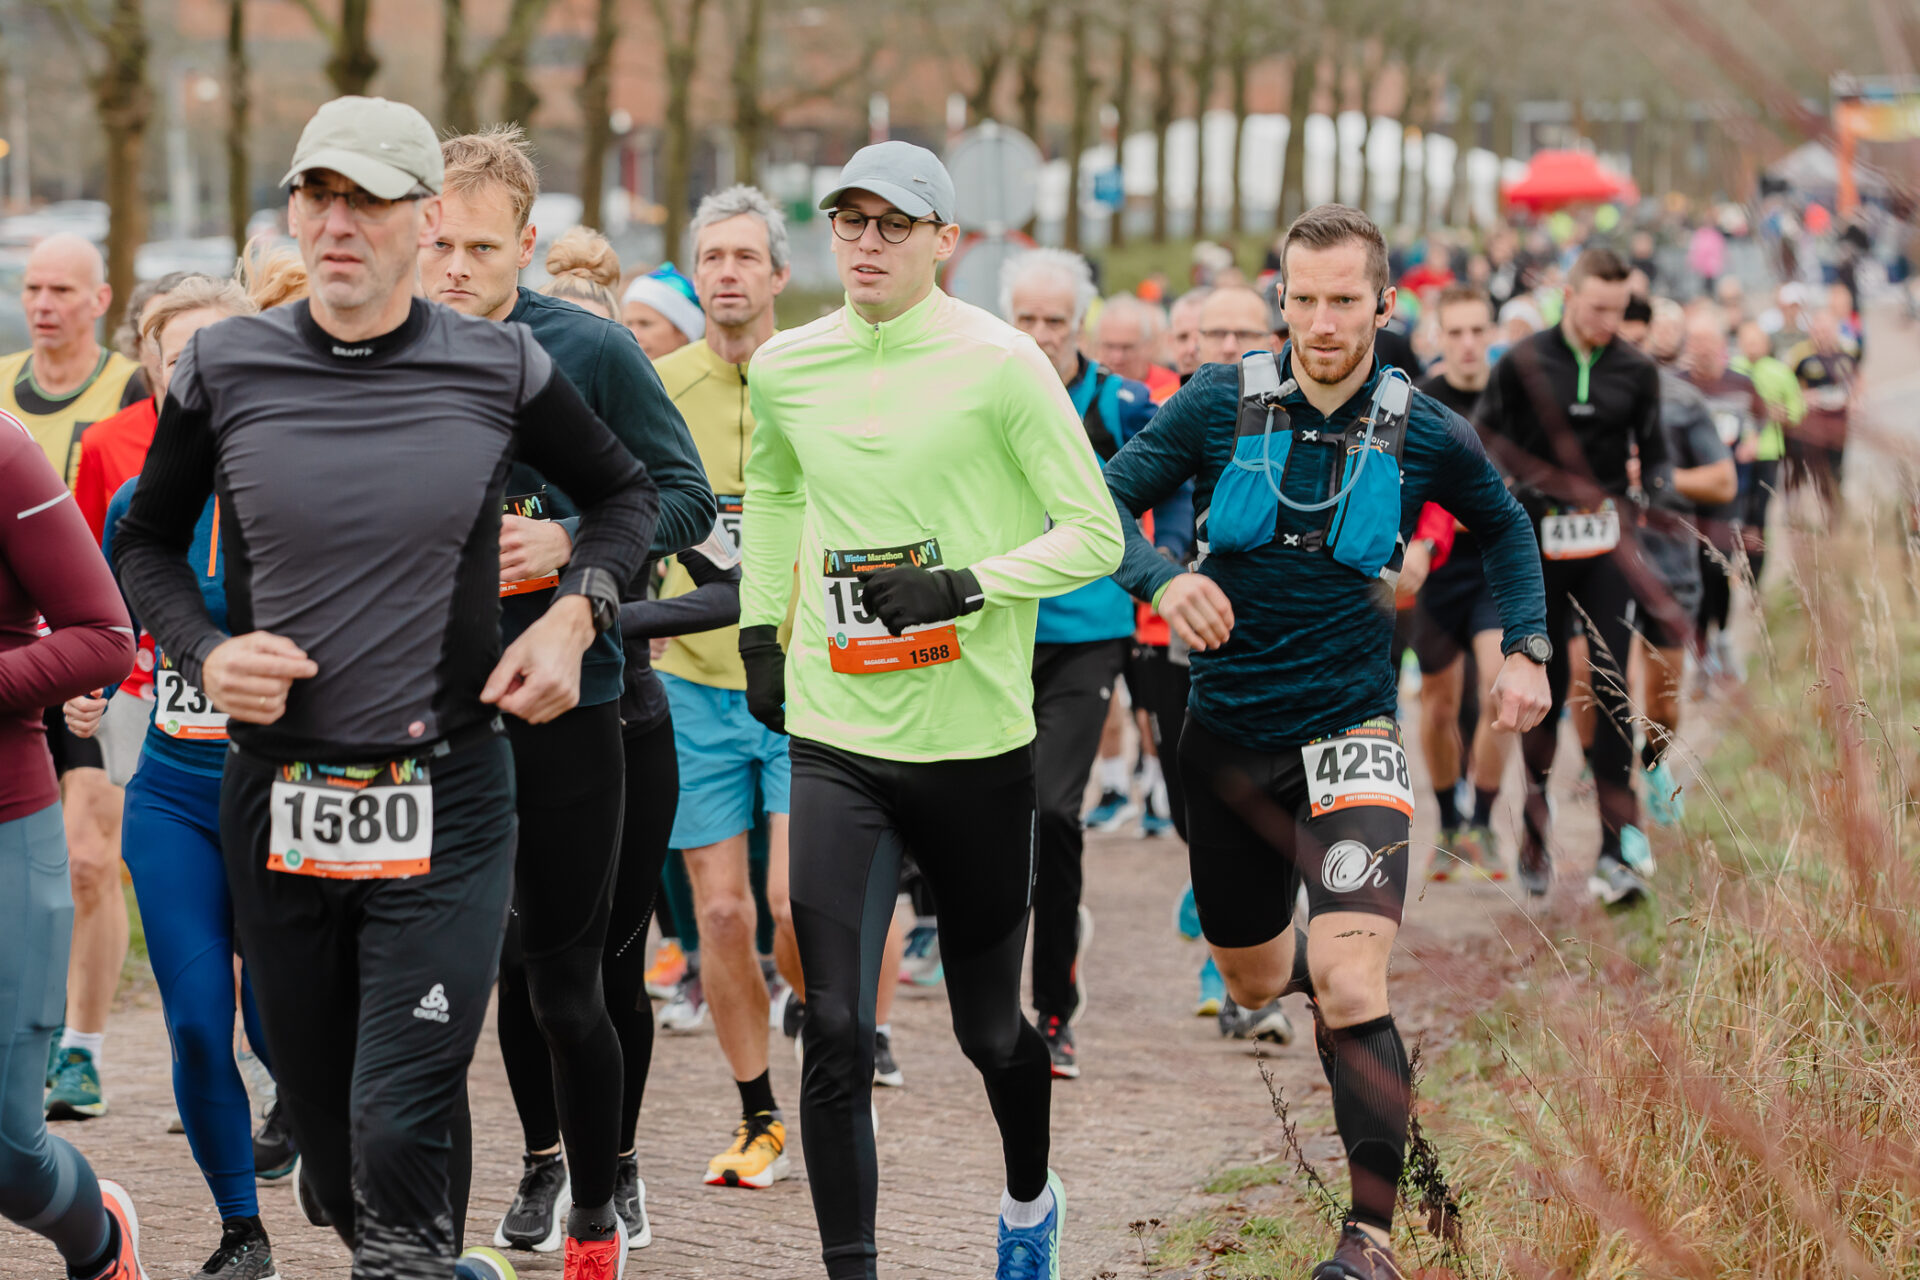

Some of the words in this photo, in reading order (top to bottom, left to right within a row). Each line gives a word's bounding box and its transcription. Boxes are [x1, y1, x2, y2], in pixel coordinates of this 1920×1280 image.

[1357, 430, 1390, 449] EVDICT
[1551, 519, 1609, 541] 4147
[844, 554, 867, 563] Winter
[867, 551, 904, 562] Marathon
[828, 581, 879, 624] 15
[908, 644, 951, 665] 1588
[165, 675, 221, 714] 23
[1346, 727, 1390, 738] Leeuwarden
[1316, 742, 1410, 791] 4258
[284, 791, 418, 844] 1580
